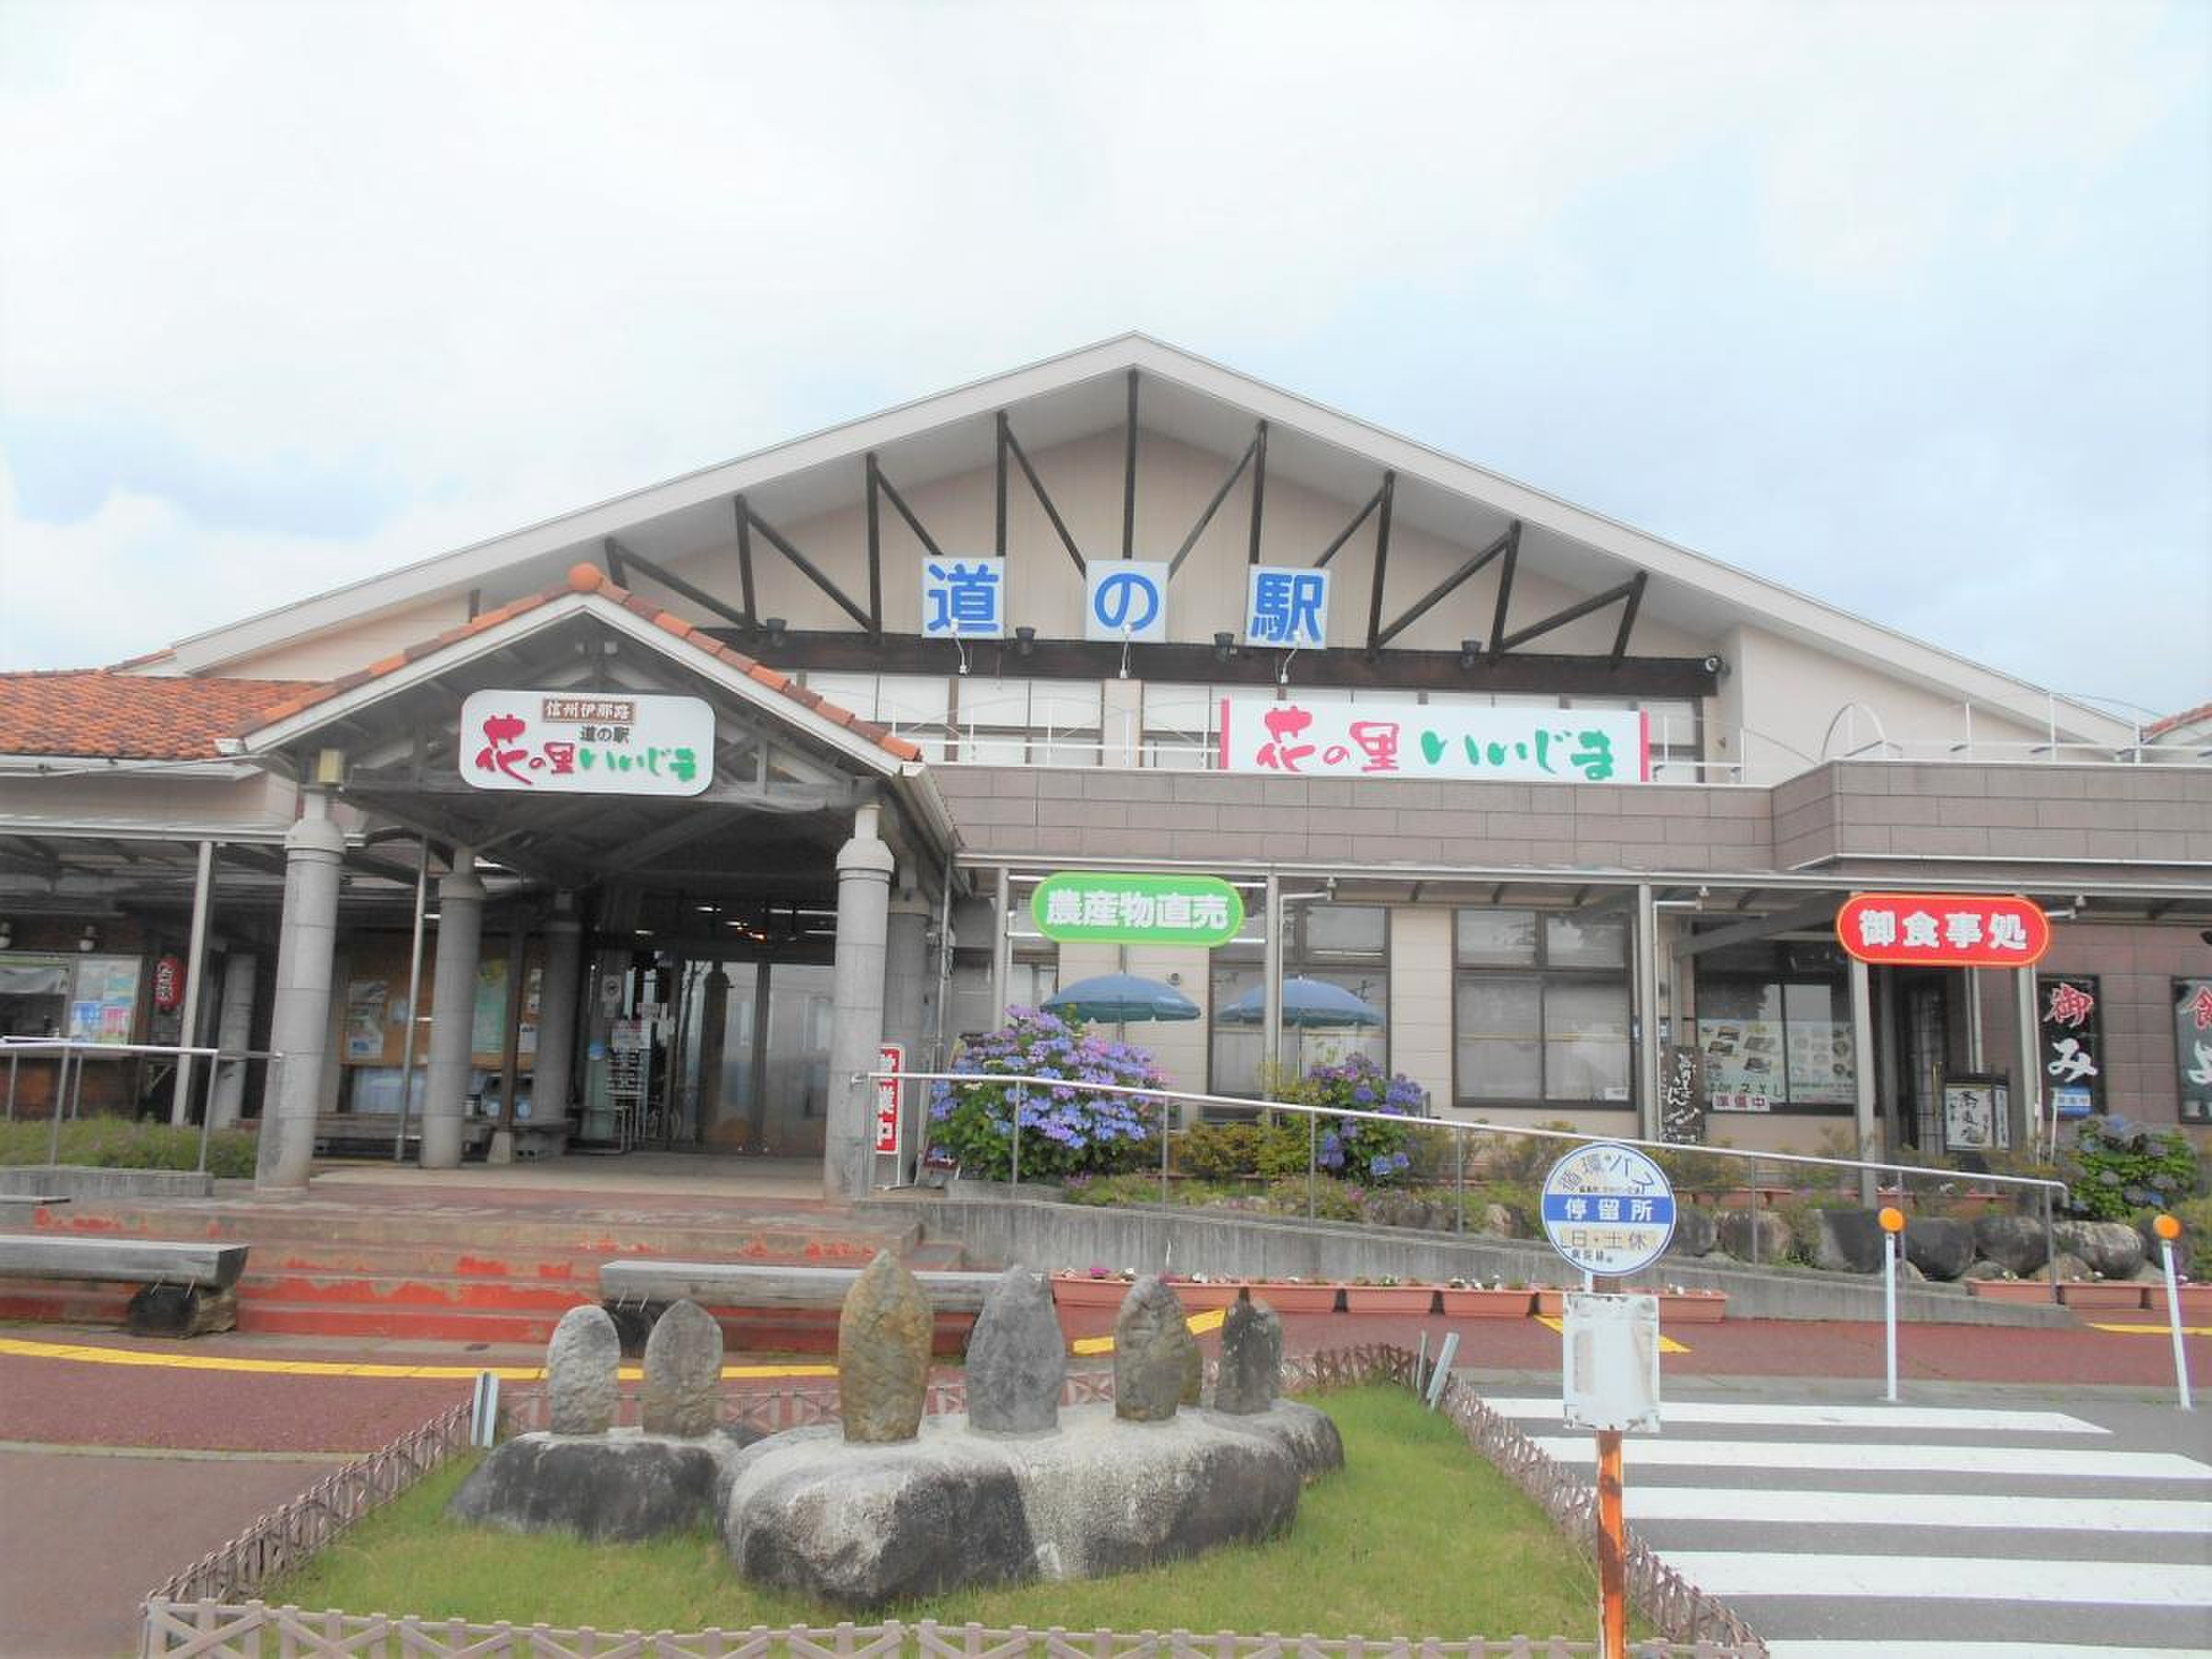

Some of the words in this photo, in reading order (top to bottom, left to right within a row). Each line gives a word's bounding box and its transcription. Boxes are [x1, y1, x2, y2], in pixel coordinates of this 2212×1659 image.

[928, 564, 1324, 643] 道の駅
[545, 700, 631, 721] 信州伊那路
[580, 725, 630, 744] 道の駅
[1047, 888, 1230, 930] 農産物直売
[1859, 910, 2027, 949] 御食事処
[1564, 1197, 1654, 1221] 停留所
